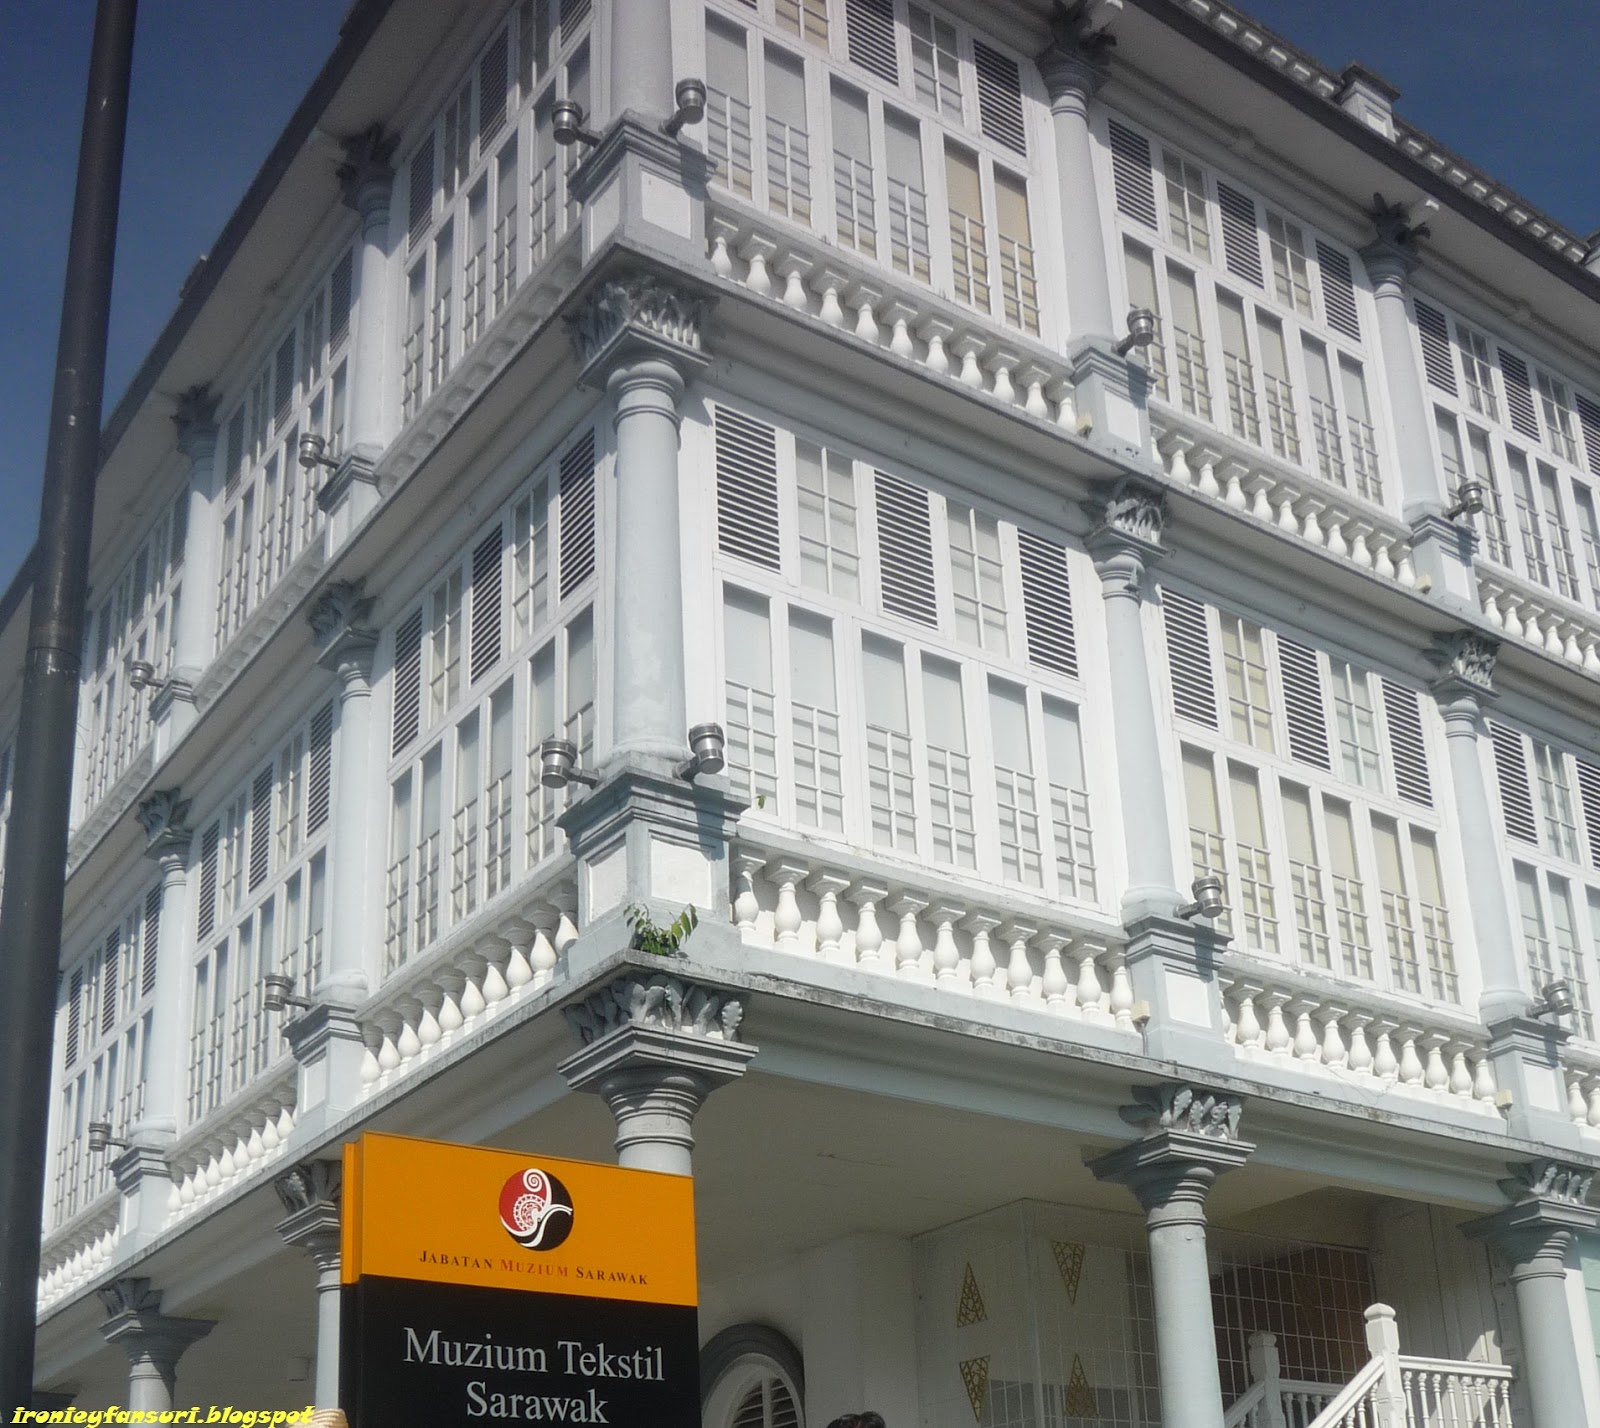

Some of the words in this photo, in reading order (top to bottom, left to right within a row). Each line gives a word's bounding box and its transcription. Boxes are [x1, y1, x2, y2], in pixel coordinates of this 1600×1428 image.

[419, 1250, 493, 1269] JABATAN
[501, 1259, 569, 1277] MUZIUM
[575, 1266, 649, 1285] SARAWAK
[403, 1327, 548, 1373] Muzium
[557, 1340, 666, 1381] Tekstil
[466, 1381, 609, 1424] Sarawak
